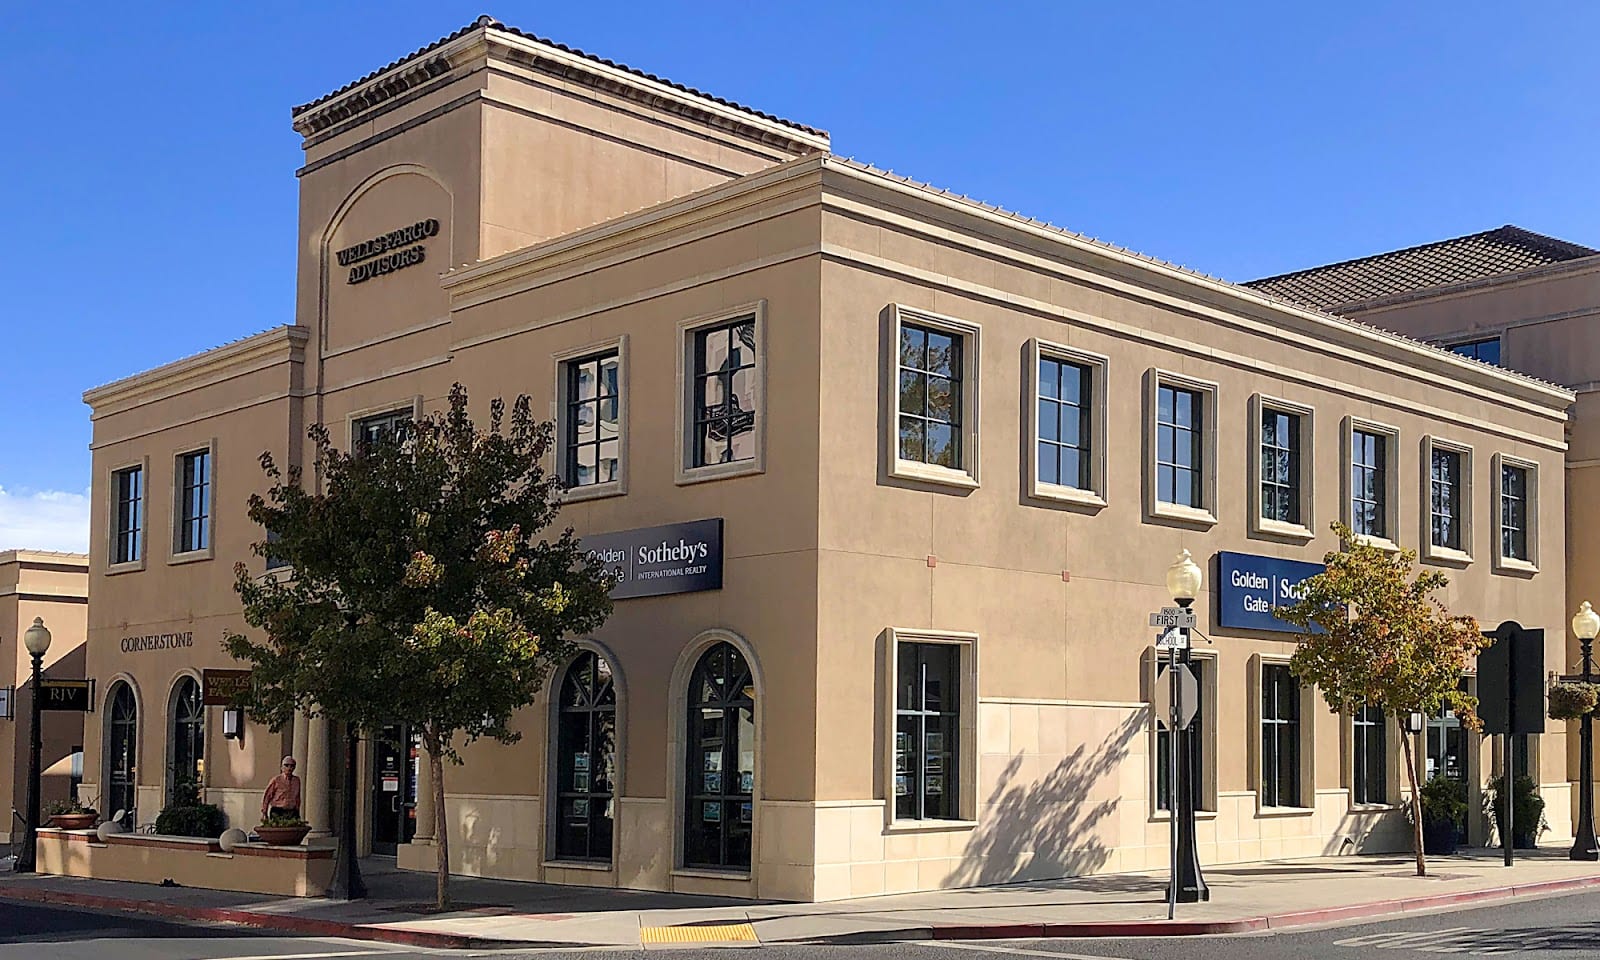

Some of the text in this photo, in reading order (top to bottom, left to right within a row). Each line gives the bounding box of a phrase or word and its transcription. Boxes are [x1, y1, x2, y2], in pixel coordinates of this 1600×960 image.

[336, 219, 440, 266] WELLS FARGO
[347, 245, 426, 284] ADVISORS
[638, 539, 708, 565] Sotheby's
[637, 565, 707, 580] INTERNATIONAL REALTY
[1231, 569, 1269, 590] Golden
[1243, 594, 1269, 613] Gate
[1156, 615, 1179, 626] FIRST
[121, 631, 193, 653] CORNERSTONE
